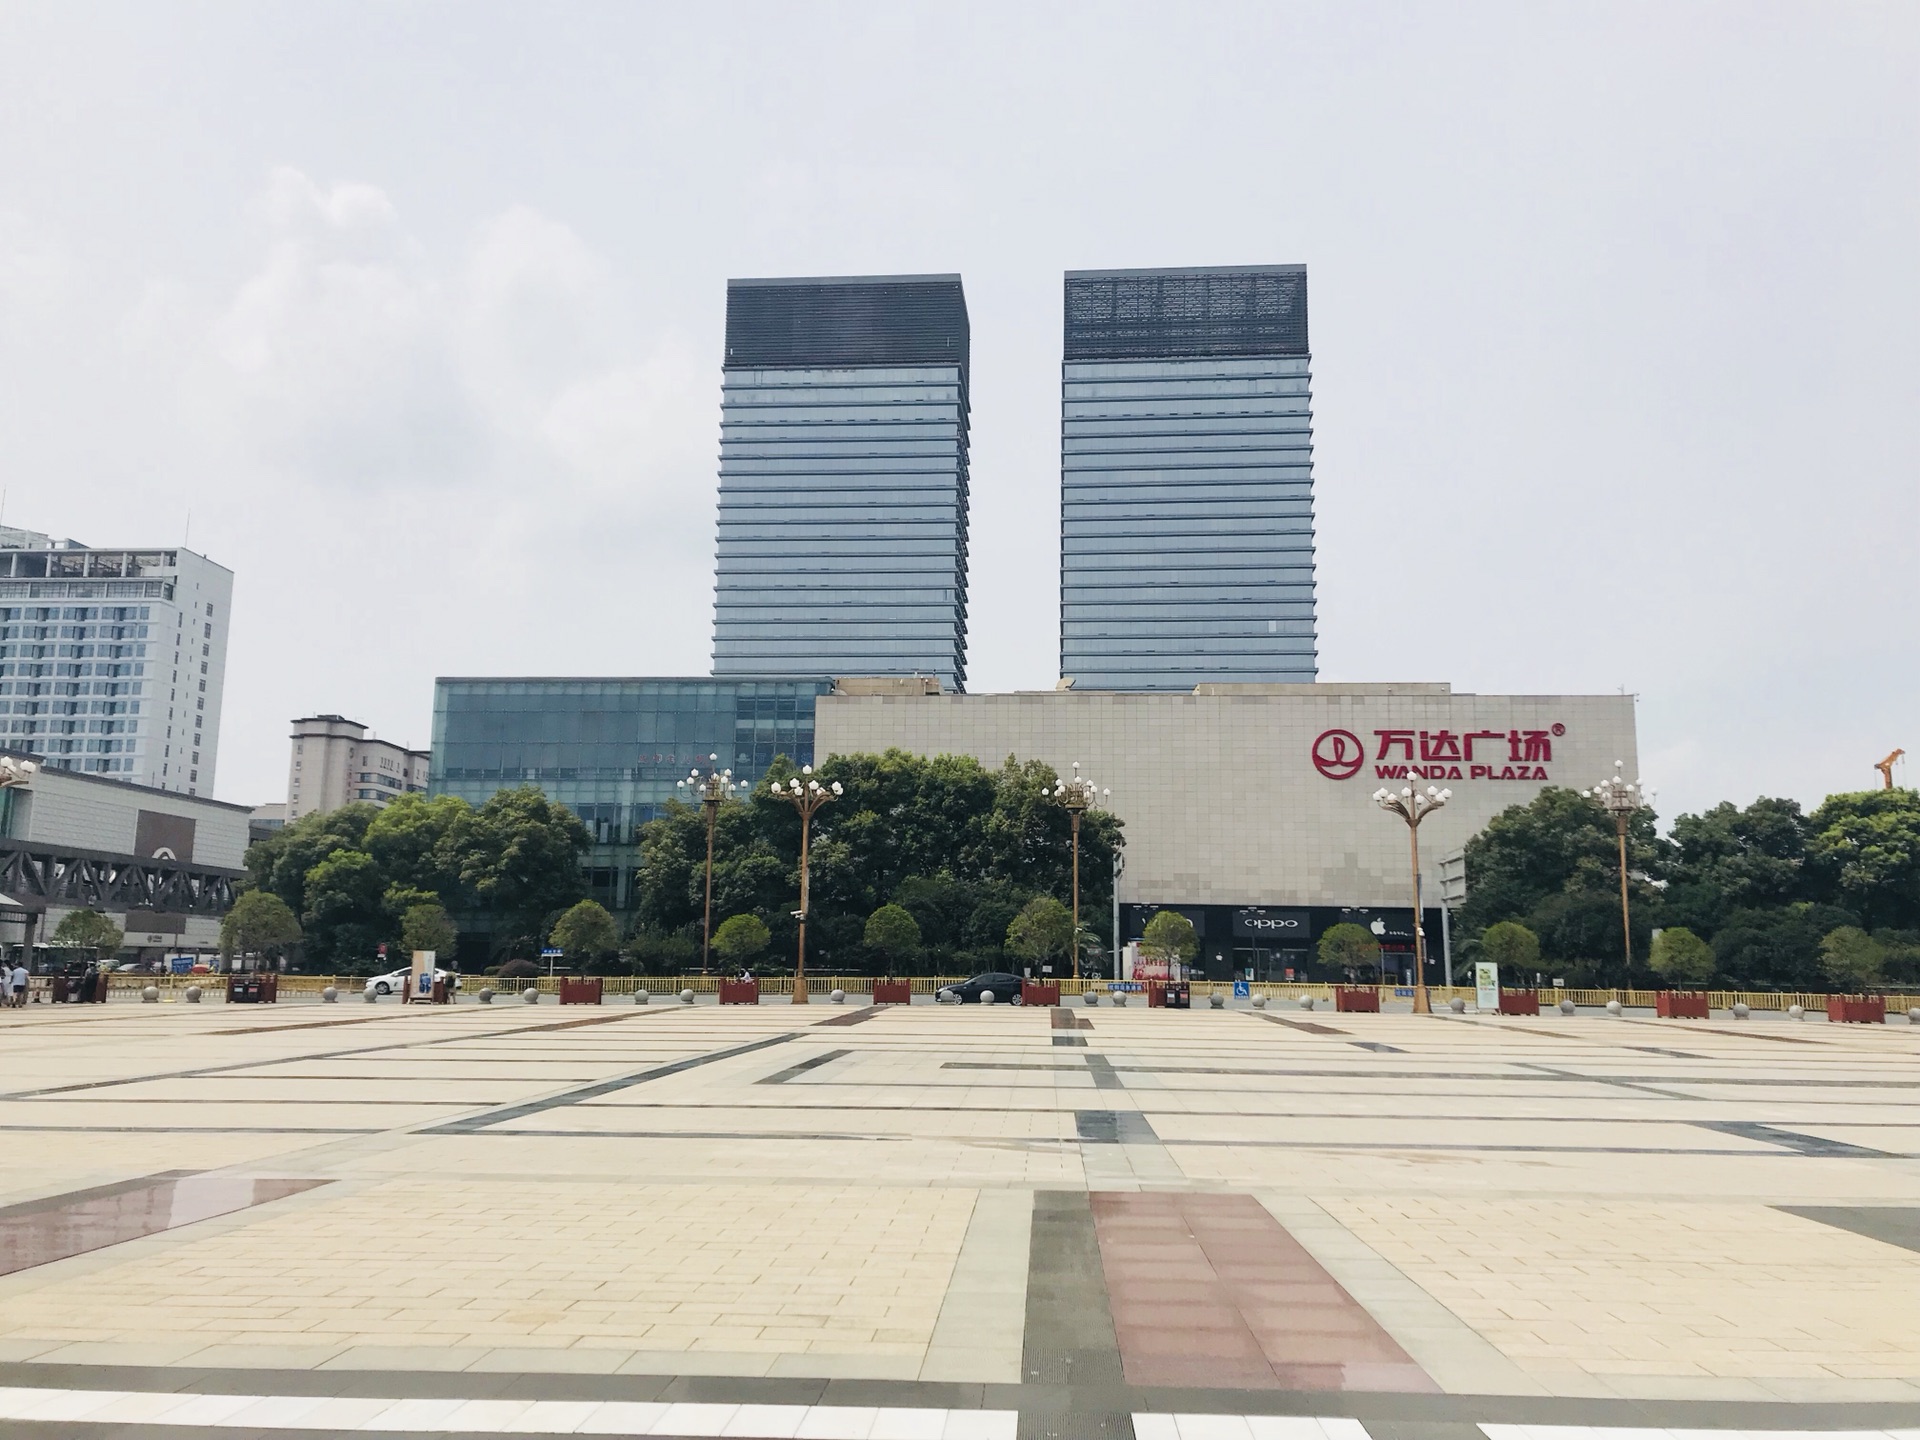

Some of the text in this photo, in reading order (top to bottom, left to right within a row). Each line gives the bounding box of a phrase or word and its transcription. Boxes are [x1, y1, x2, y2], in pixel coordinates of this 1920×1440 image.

[1374, 729, 1552, 762] 万达广场
[1375, 765, 1549, 780] WANDA PLAZA
